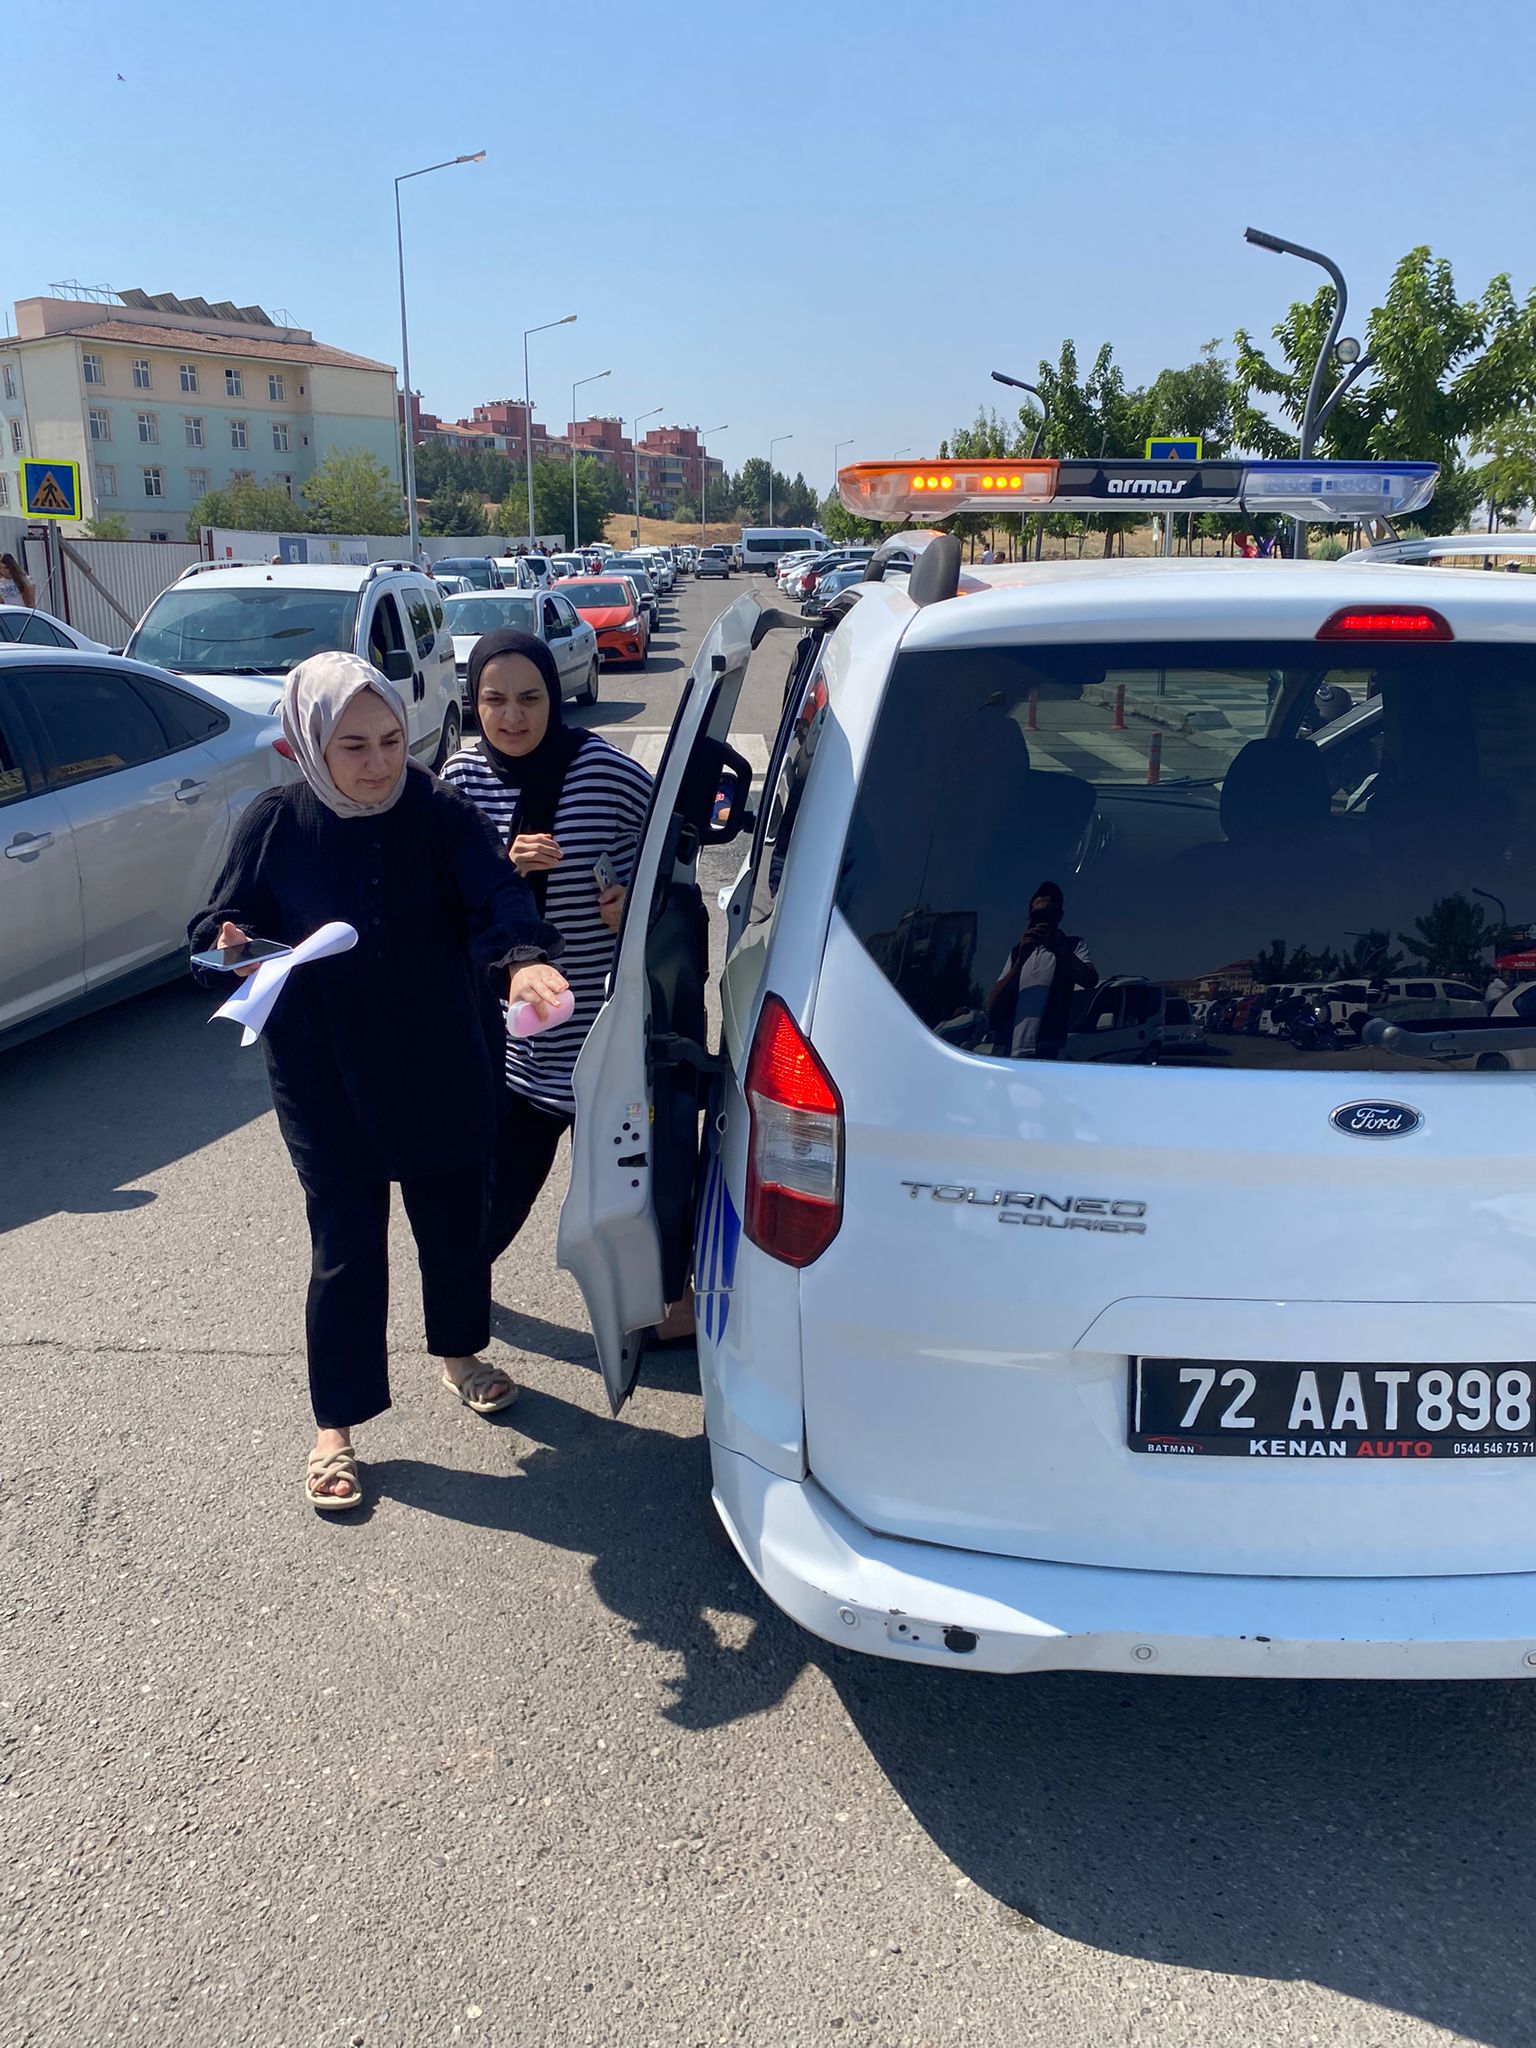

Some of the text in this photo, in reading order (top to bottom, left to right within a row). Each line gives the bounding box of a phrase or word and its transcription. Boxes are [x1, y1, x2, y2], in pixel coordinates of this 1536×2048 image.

[1107, 479, 1187, 494] armas
[1351, 1107, 1403, 1130] Ford
[900, 1180, 1147, 1217] TOURNEO
[998, 1211, 1147, 1235] COURIER
[1179, 1367, 1257, 1429] 72
[1147, 1443, 1195, 1454] BATMAN
[1249, 1439, 1433, 1457] KENAN AUTO
[1453, 1442, 1534, 1455] 0544 546 75 71
